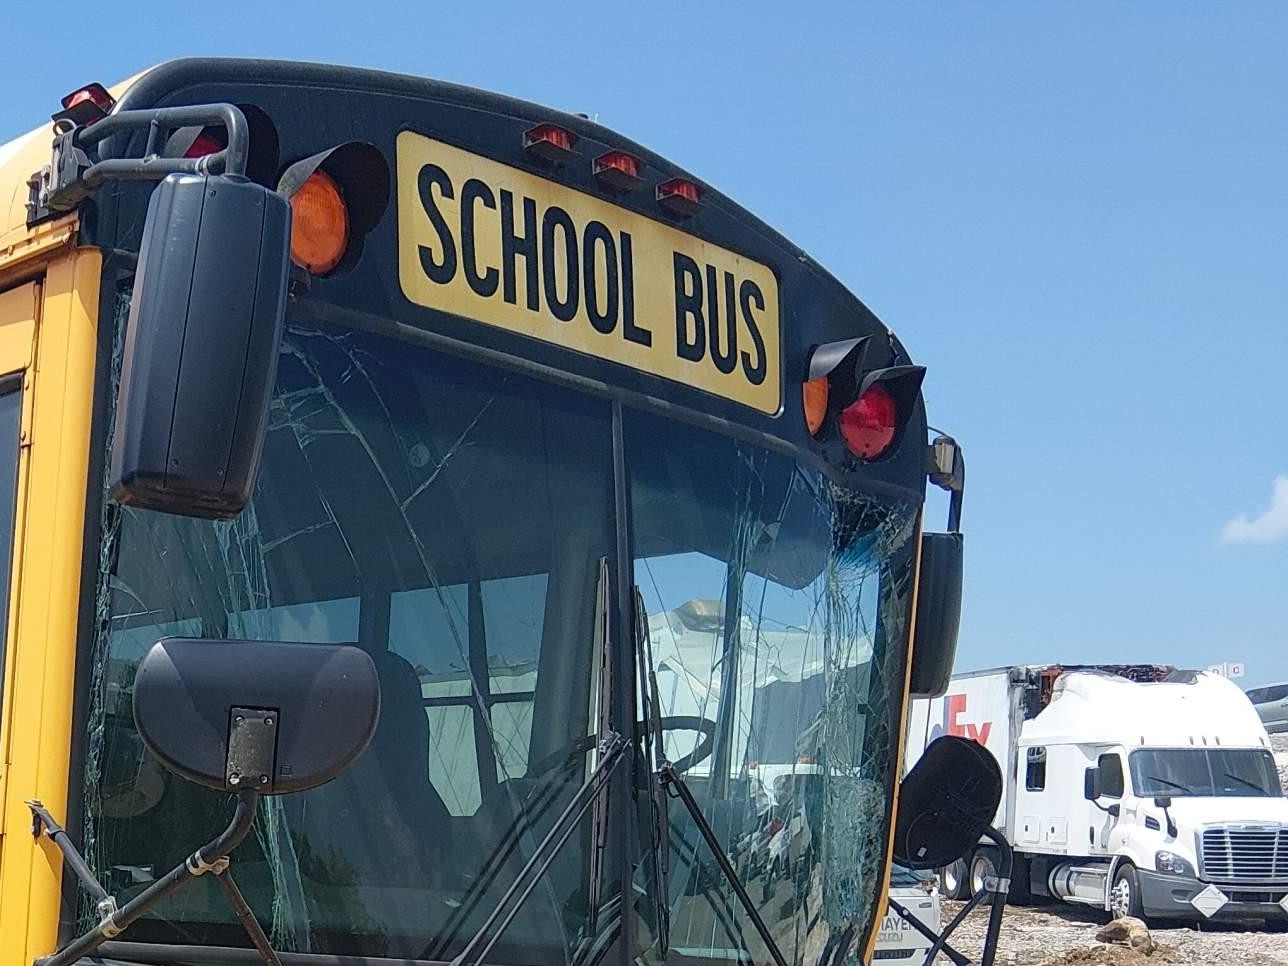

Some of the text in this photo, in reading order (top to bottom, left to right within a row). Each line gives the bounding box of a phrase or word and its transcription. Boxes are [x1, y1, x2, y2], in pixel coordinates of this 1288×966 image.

[416, 162, 768, 387] SCHOOL BUS
[881, 917, 912, 931] AYE
